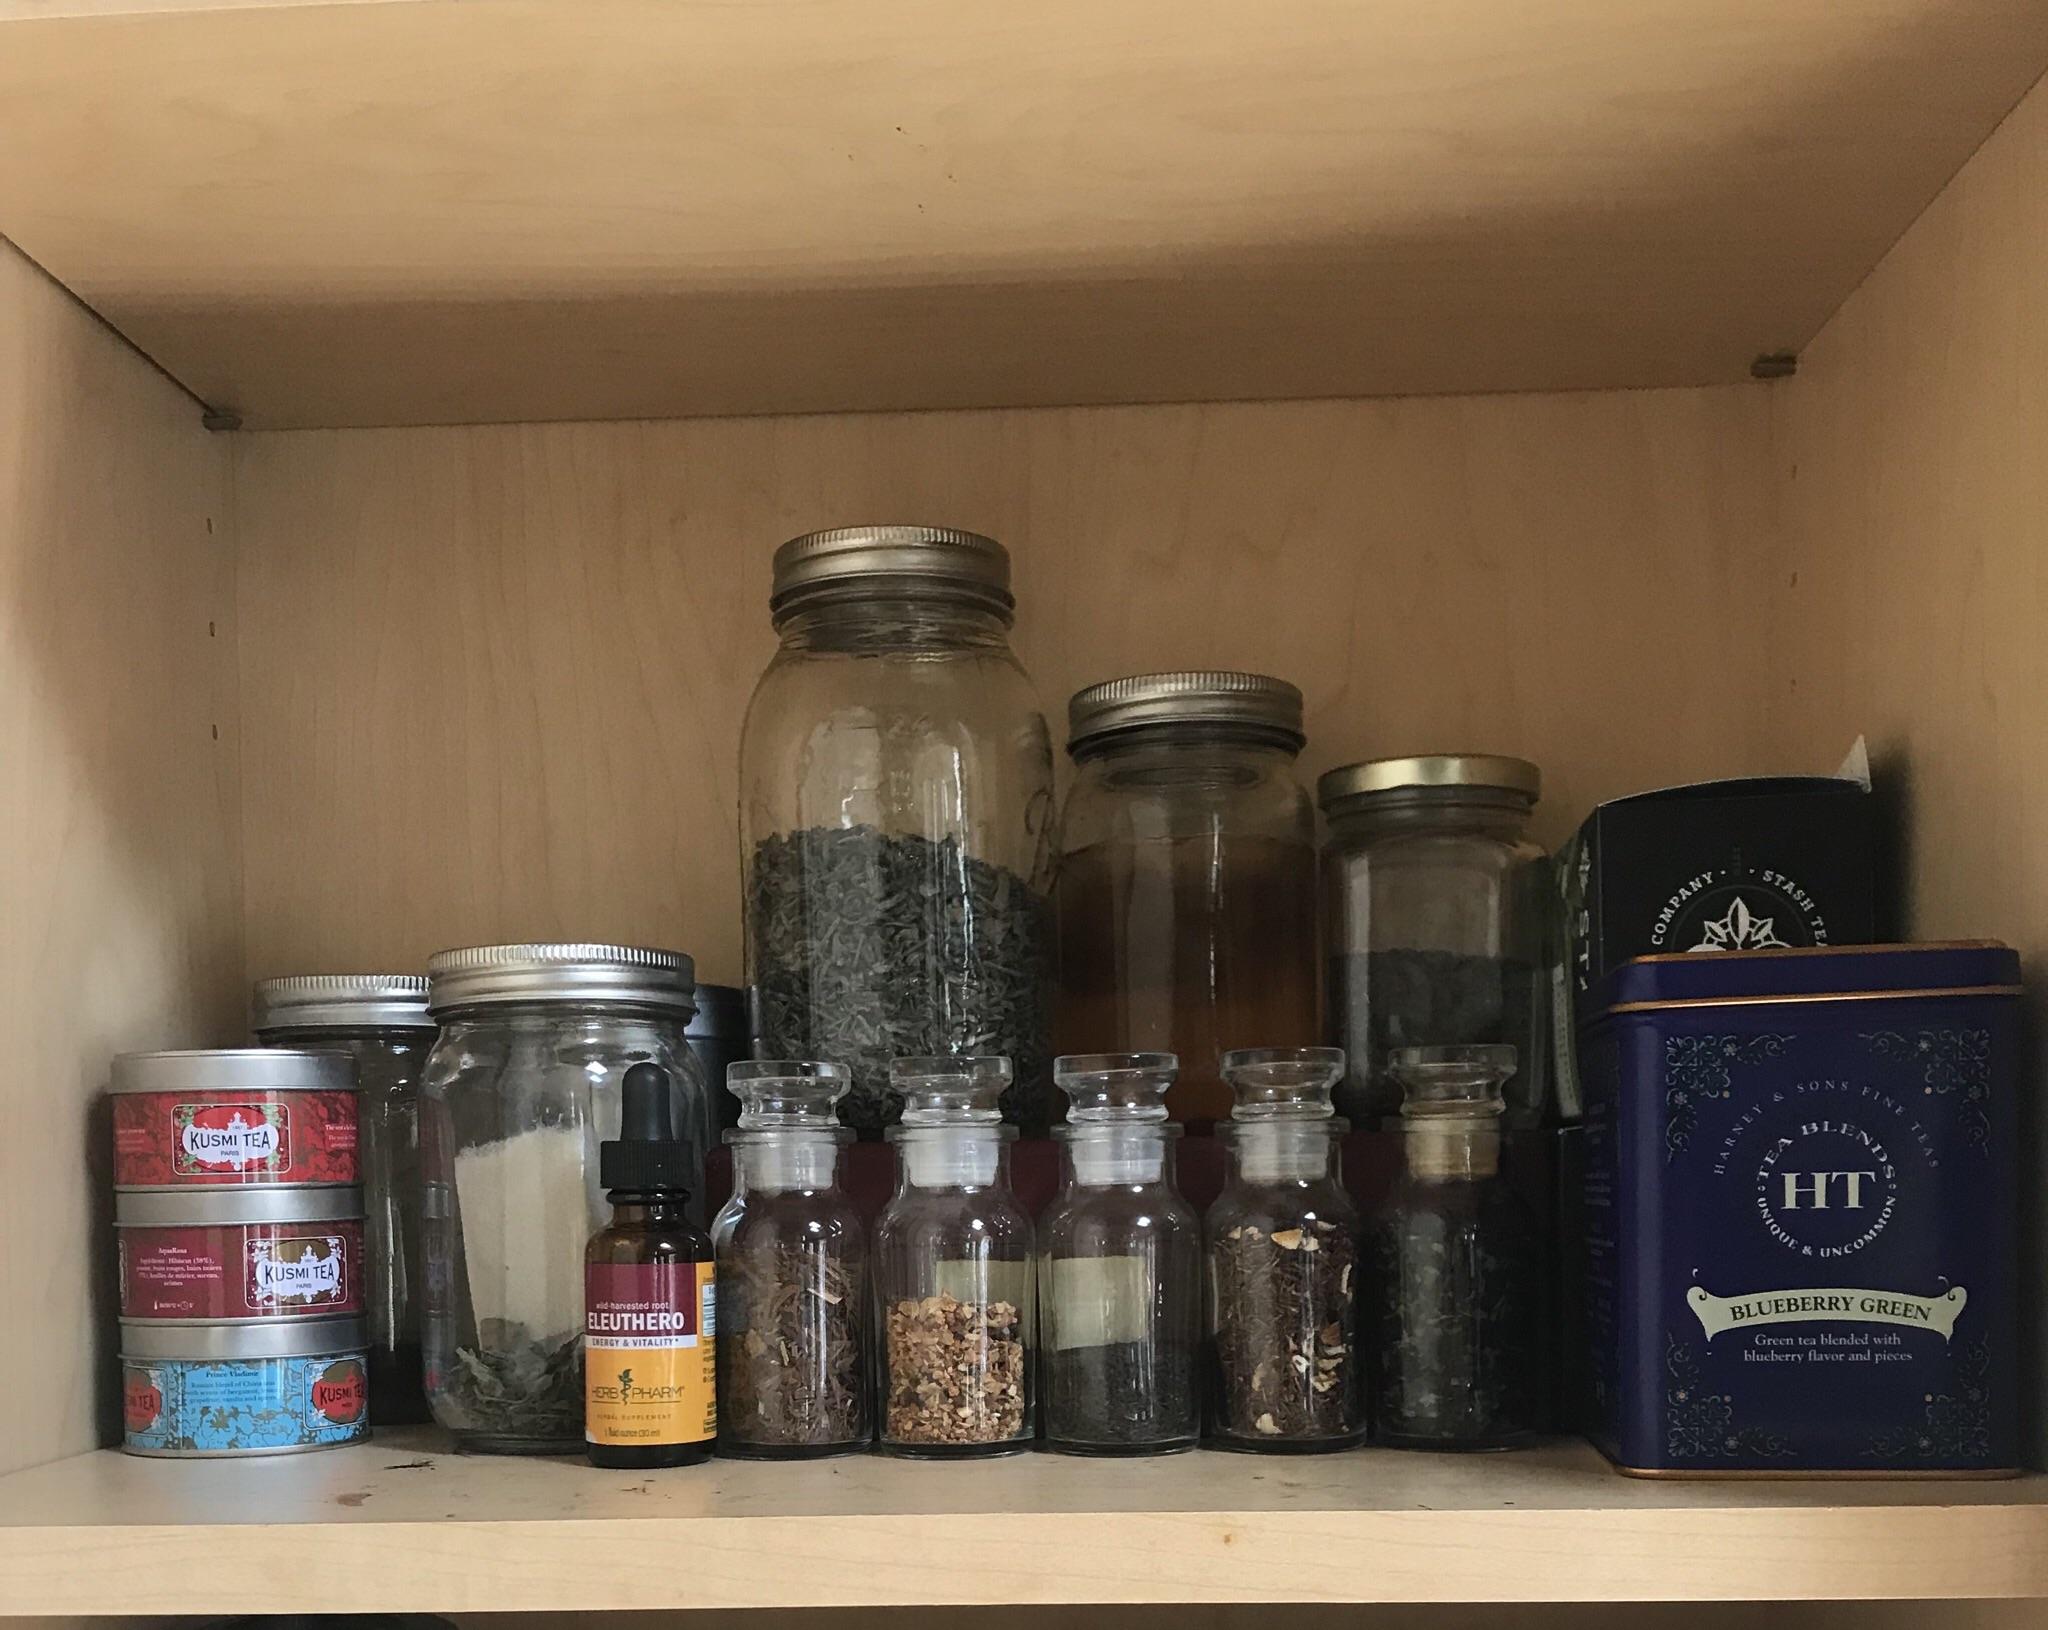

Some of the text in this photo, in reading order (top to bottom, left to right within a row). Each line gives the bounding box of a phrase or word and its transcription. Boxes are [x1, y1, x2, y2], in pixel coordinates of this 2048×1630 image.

[1762, 870, 1815, 912] STASH
[1651, 871, 1713, 945] COMPANY
[1713, 1103, 1762, 1175] HARNEY
[1797, 1080, 1849, 1093] SONS
[1862, 1086, 1905, 1115] FINE
[1911, 1121, 1938, 1168] TEAS
[190, 1131, 271, 1151] KUSMI TEA
[1756, 1121, 1896, 1182] TEA BLENDS
[1780, 1171, 1876, 1210] HT
[1757, 1195, 1896, 1258] UNIQUE & UNCOMMON
[265, 1263, 335, 1285] KUSMI TEA
[651, 1302, 670, 1310] root
[1729, 1296, 1932, 1321] BLUEBERRY GREEN
[588, 1312, 685, 1331] ELEUTHERO
[592, 1338, 619, 1347] ENERGY
[622, 1338, 629, 1346] &
[1754, 1333, 1901, 1346] Green tea blended with
[1744, 1349, 1913, 1364] blueberry flavor and pieces
[139, 1394, 155, 1413] TEA
[320, 1386, 352, 1406] KUSMI
